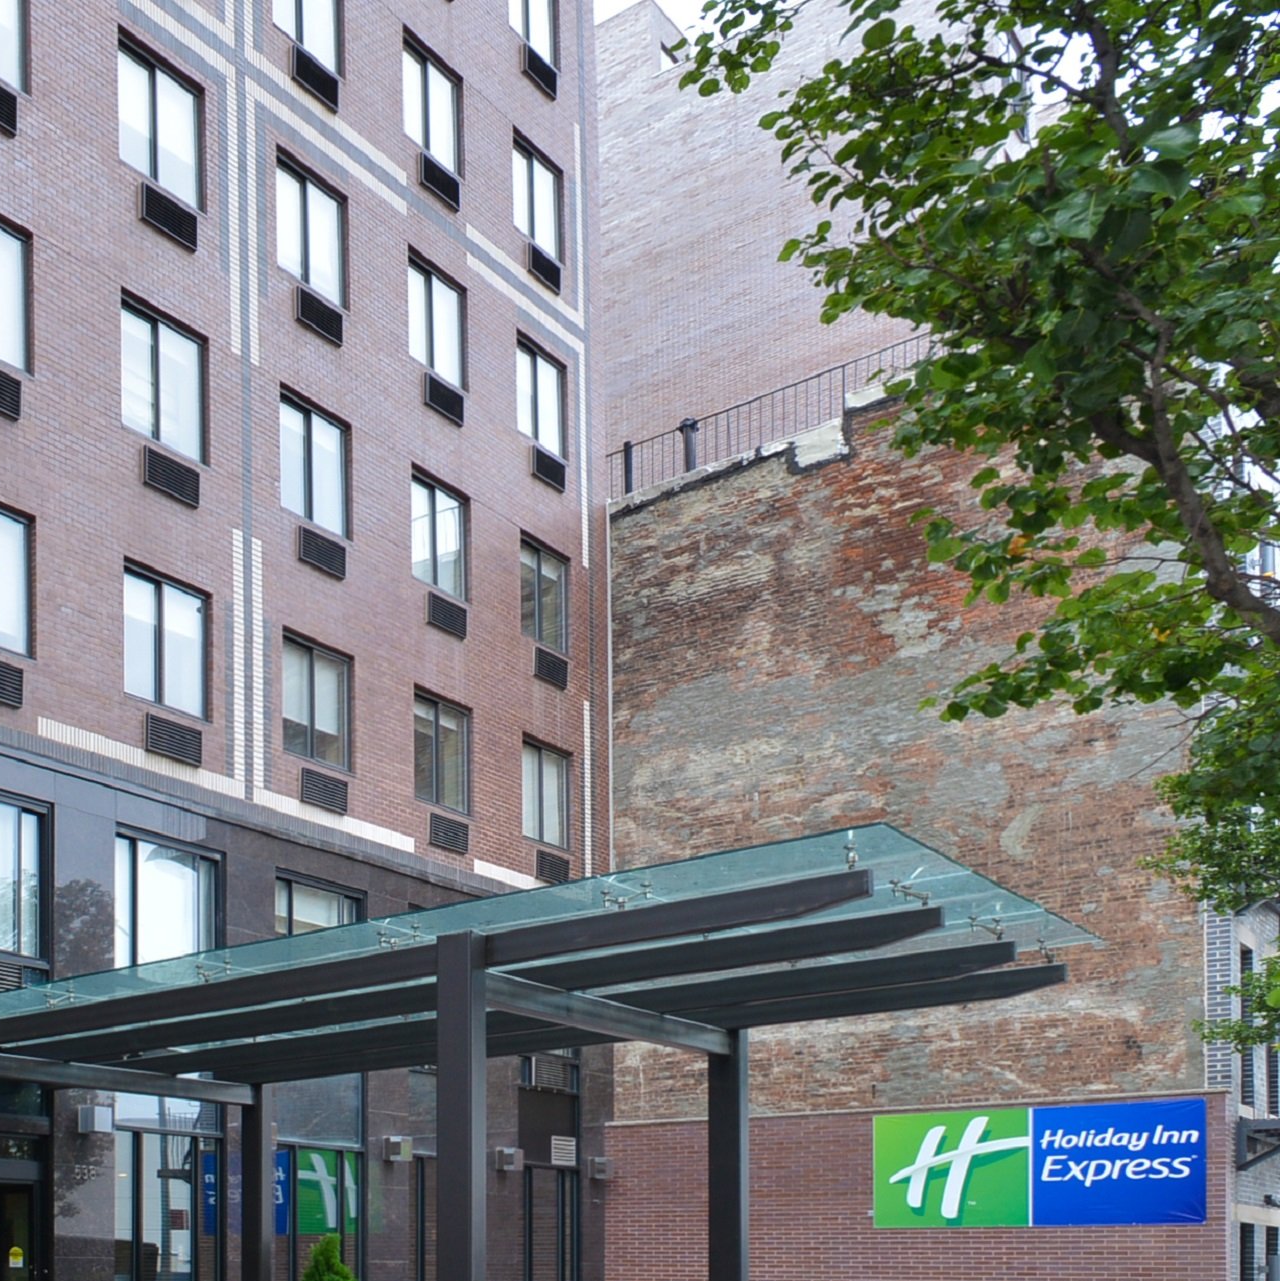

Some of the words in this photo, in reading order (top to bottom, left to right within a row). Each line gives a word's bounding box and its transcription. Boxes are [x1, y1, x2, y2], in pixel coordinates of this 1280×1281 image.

[1040, 1127, 1149, 1152] Holiday
[1152, 1124, 1200, 1145] Inn
[1041, 1154, 1193, 1188] Express
